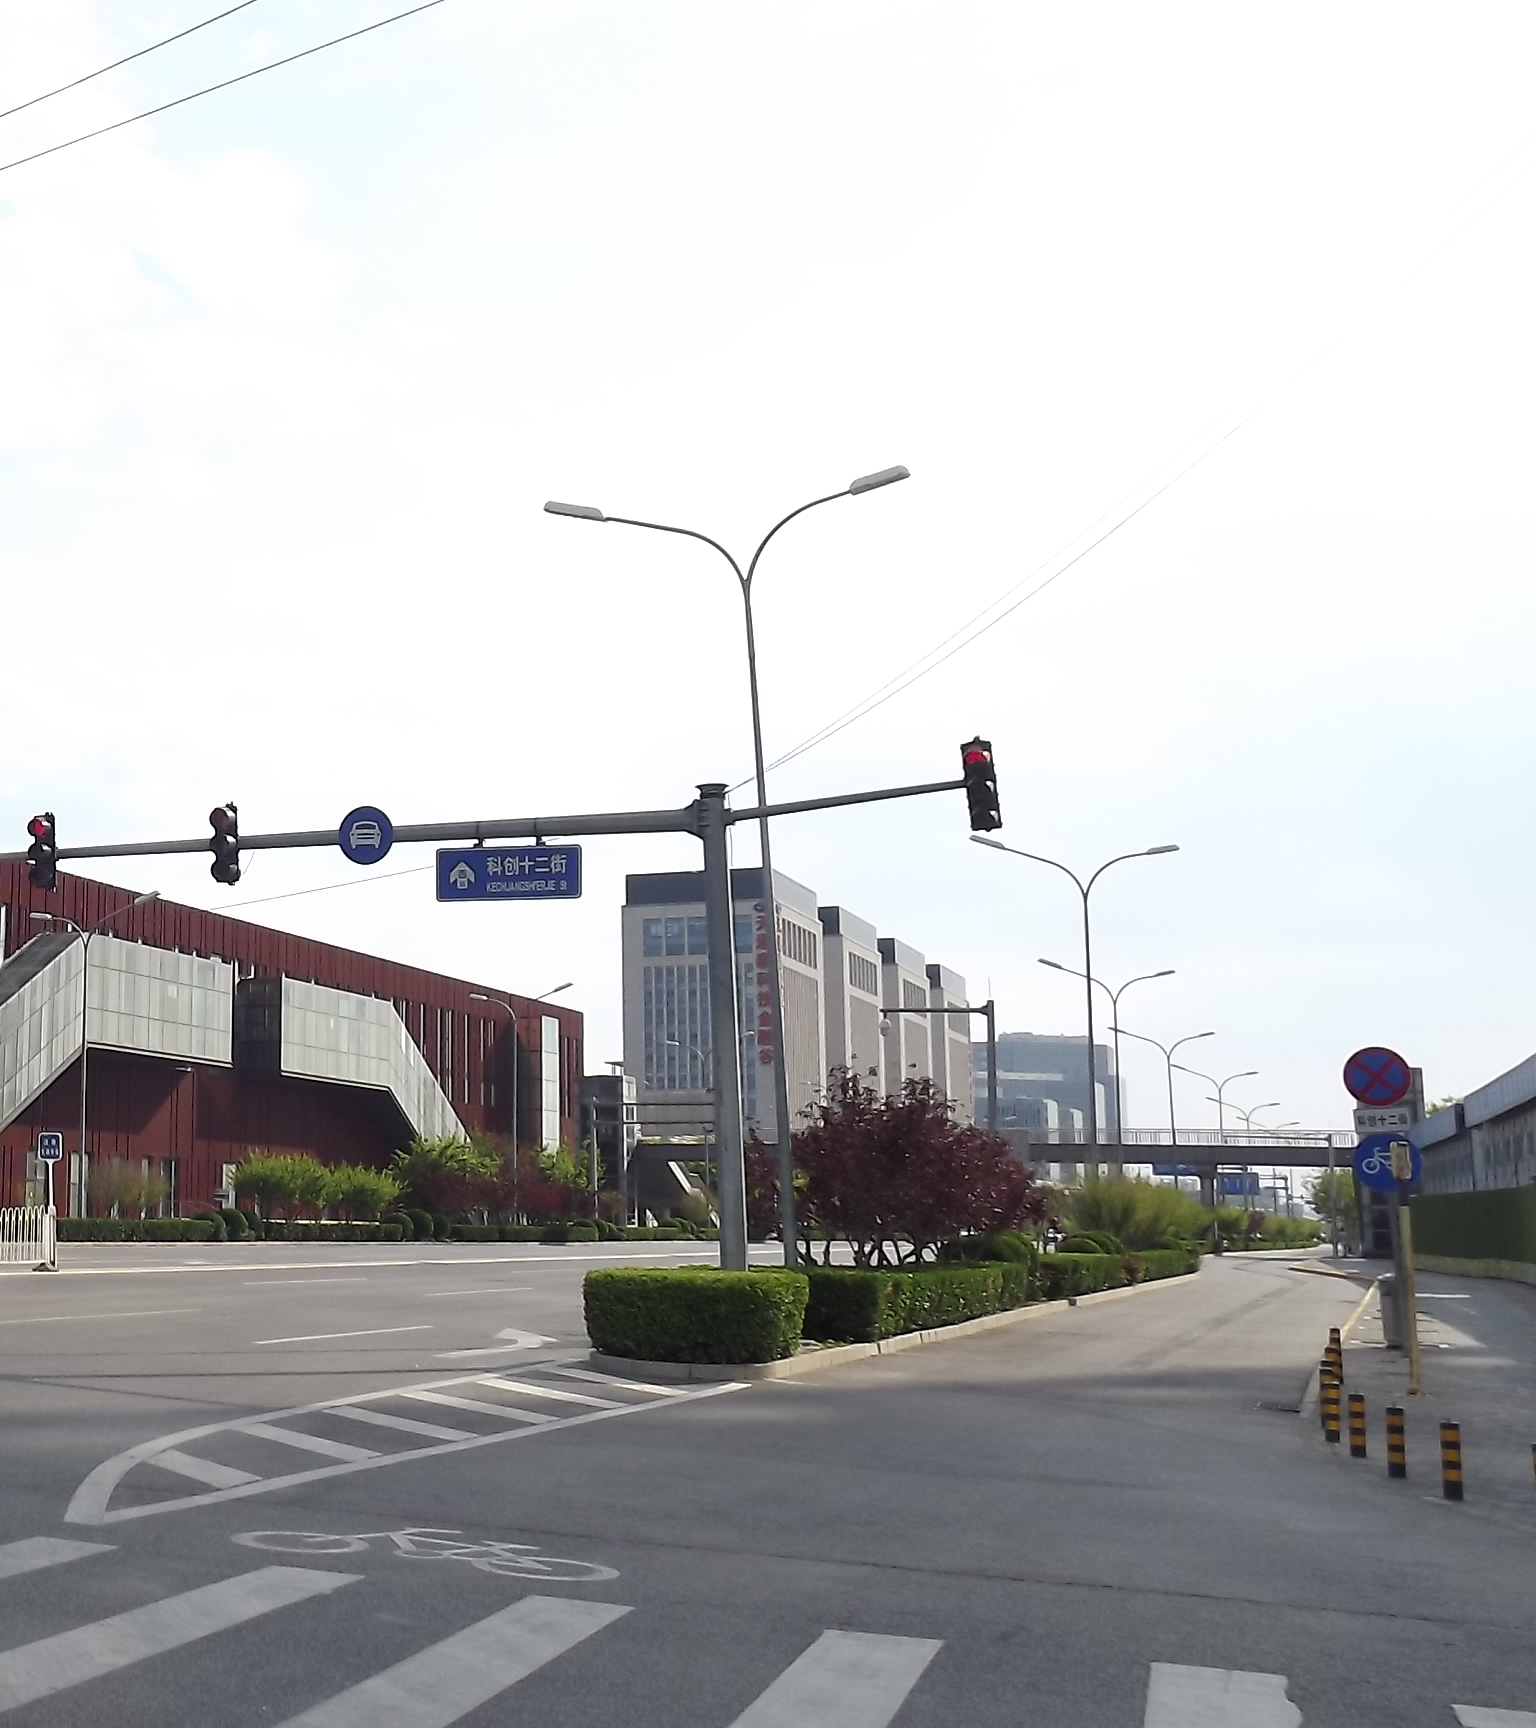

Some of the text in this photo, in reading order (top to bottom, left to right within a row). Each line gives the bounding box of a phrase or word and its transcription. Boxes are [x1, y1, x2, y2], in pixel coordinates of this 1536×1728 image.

[486, 854, 567, 876] 科创十二街
